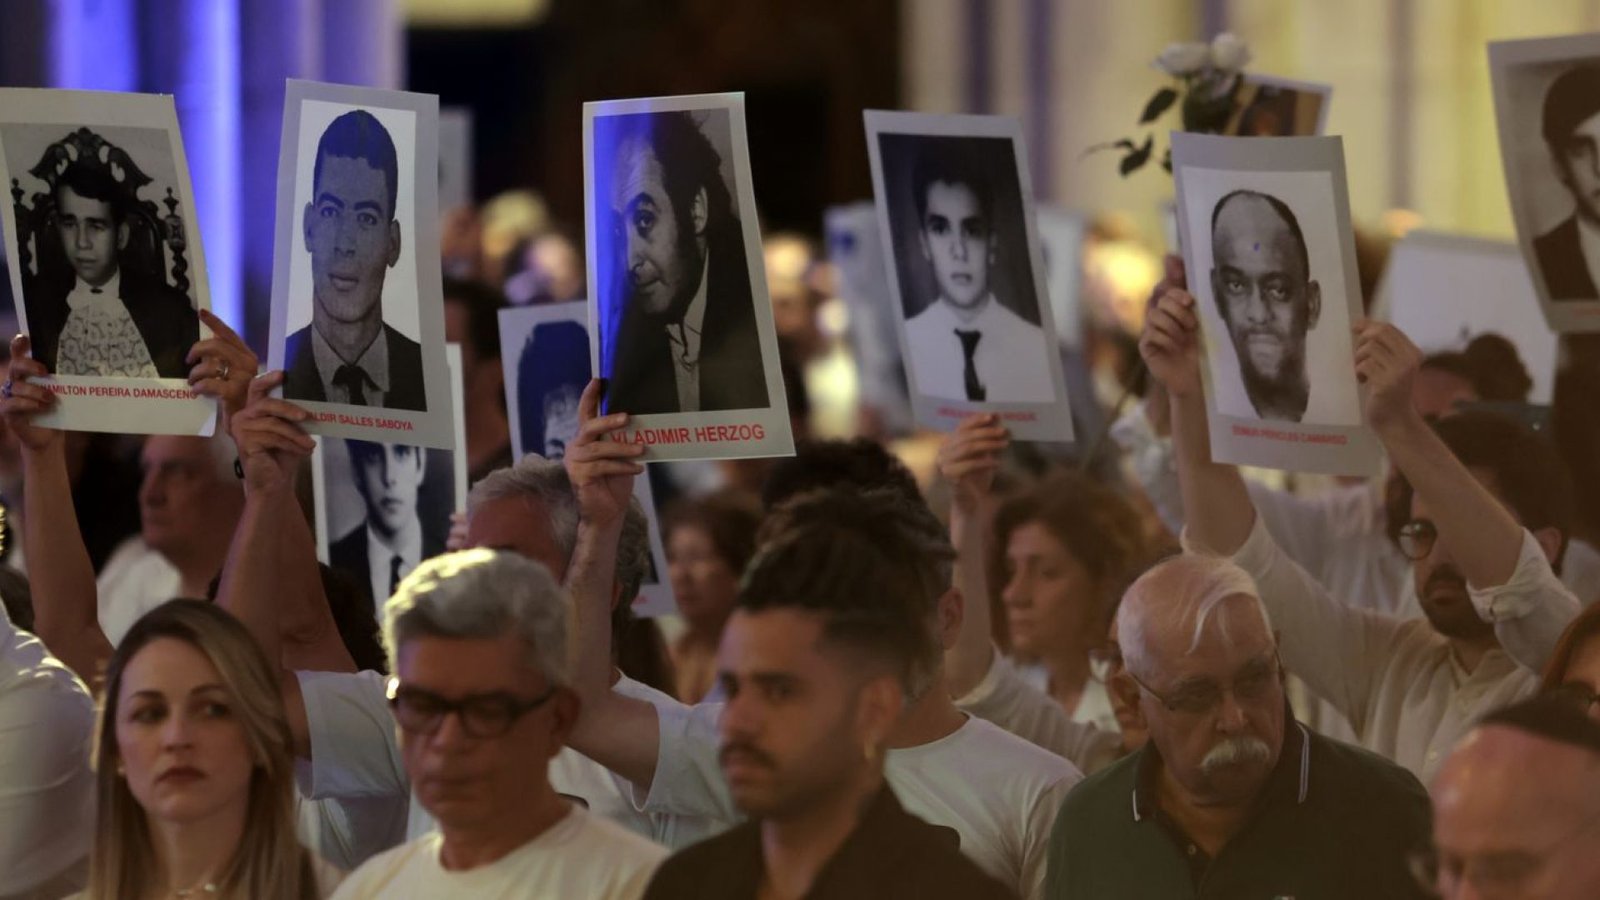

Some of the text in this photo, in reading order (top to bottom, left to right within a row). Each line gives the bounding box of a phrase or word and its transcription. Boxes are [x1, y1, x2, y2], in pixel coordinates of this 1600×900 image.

[89, 386, 131, 398] PEREIRA
[339, 415, 374, 427] SALLES
[376, 419, 413, 431] SABOYA
[695, 424, 765, 443] HERZOG
